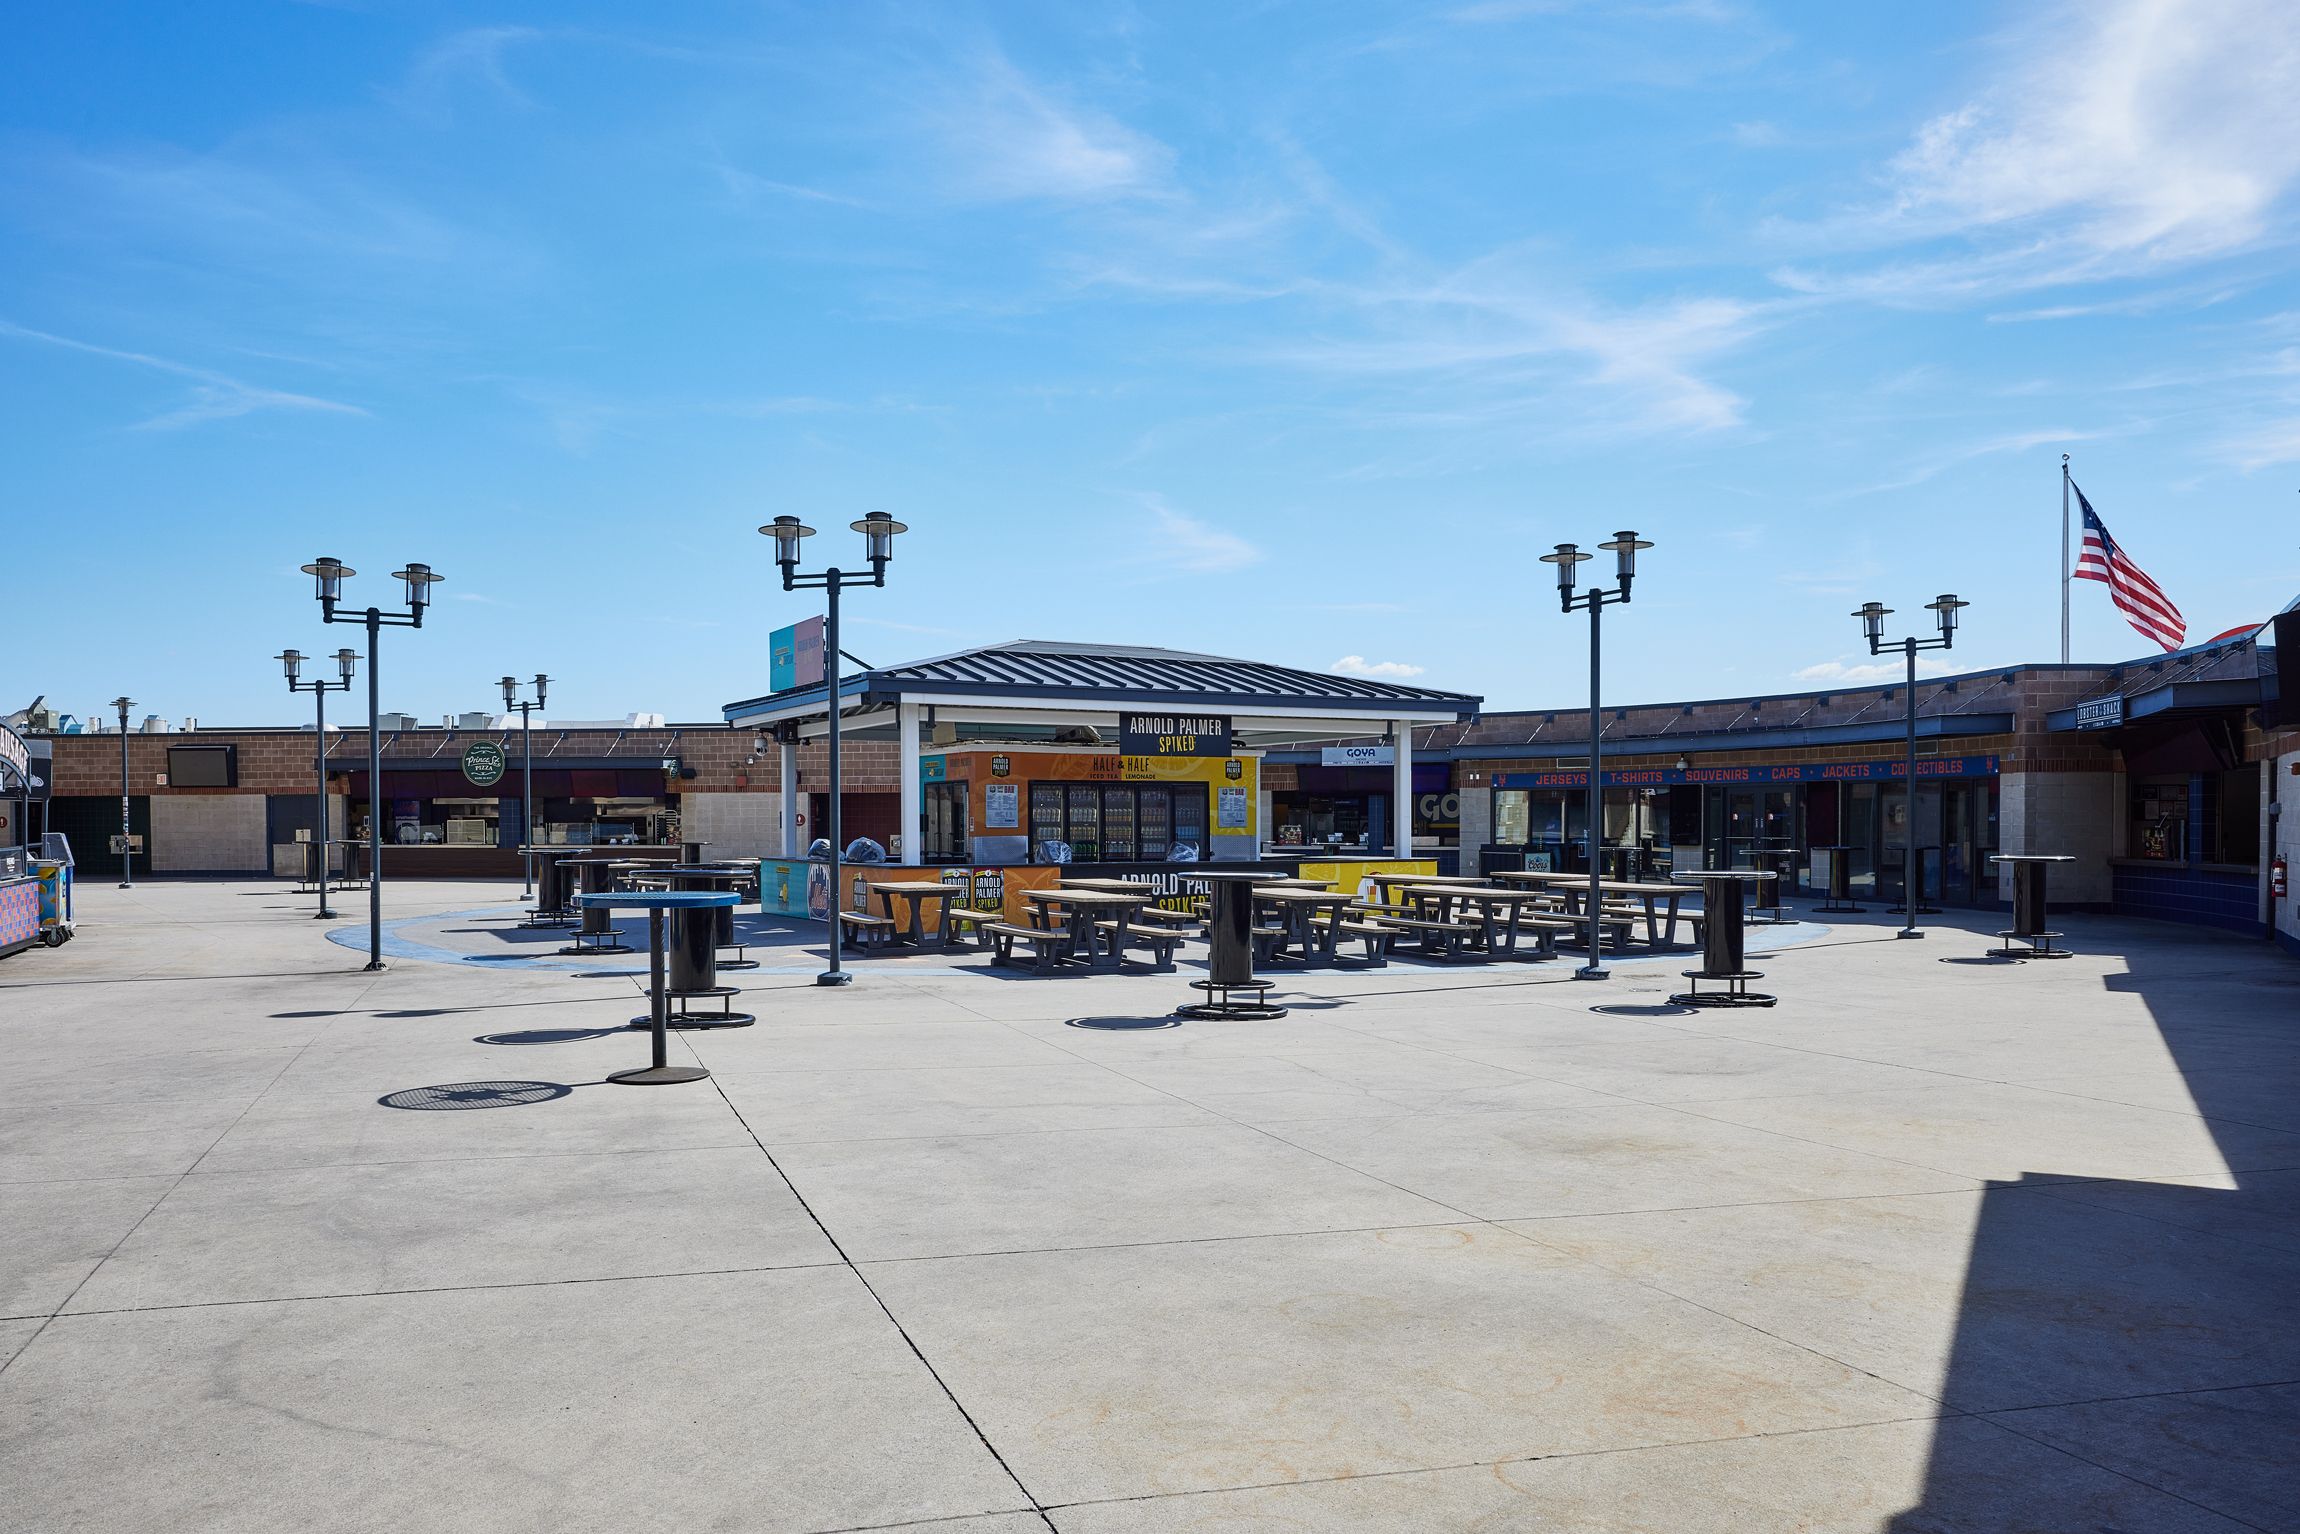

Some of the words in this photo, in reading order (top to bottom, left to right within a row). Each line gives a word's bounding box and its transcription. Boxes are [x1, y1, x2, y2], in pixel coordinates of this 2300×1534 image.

[2077, 705, 2098, 721] LOBSTER
[2103, 700, 2120, 716] SHACK
[1130, 717, 1174, 734] ARNOLD
[1179, 719, 1222, 736] PALMER
[1159, 735, 1196, 753] SPIKED
[1346, 748, 1376, 758] GOYA
[1093, 757, 1116, 772] HALF
[1118, 760, 1124, 769] &
[1128, 757, 1150, 772] HALF
[1536, 774, 1587, 785] JERSEYS
[1610, 771, 1663, 783] T-SHIRTS
[1685, 769, 1749, 781] SOUVENIRS
[1771, 767, 1801, 780] CAPS
[1822, 764, 1870, 777] JACKETS
[1891, 759, 1963, 775] COECTIBLES
[976, 878, 1000, 887] ARNOLD
[976, 888, 1000, 898] PALMER
[977, 898, 998, 908] SPIKED
